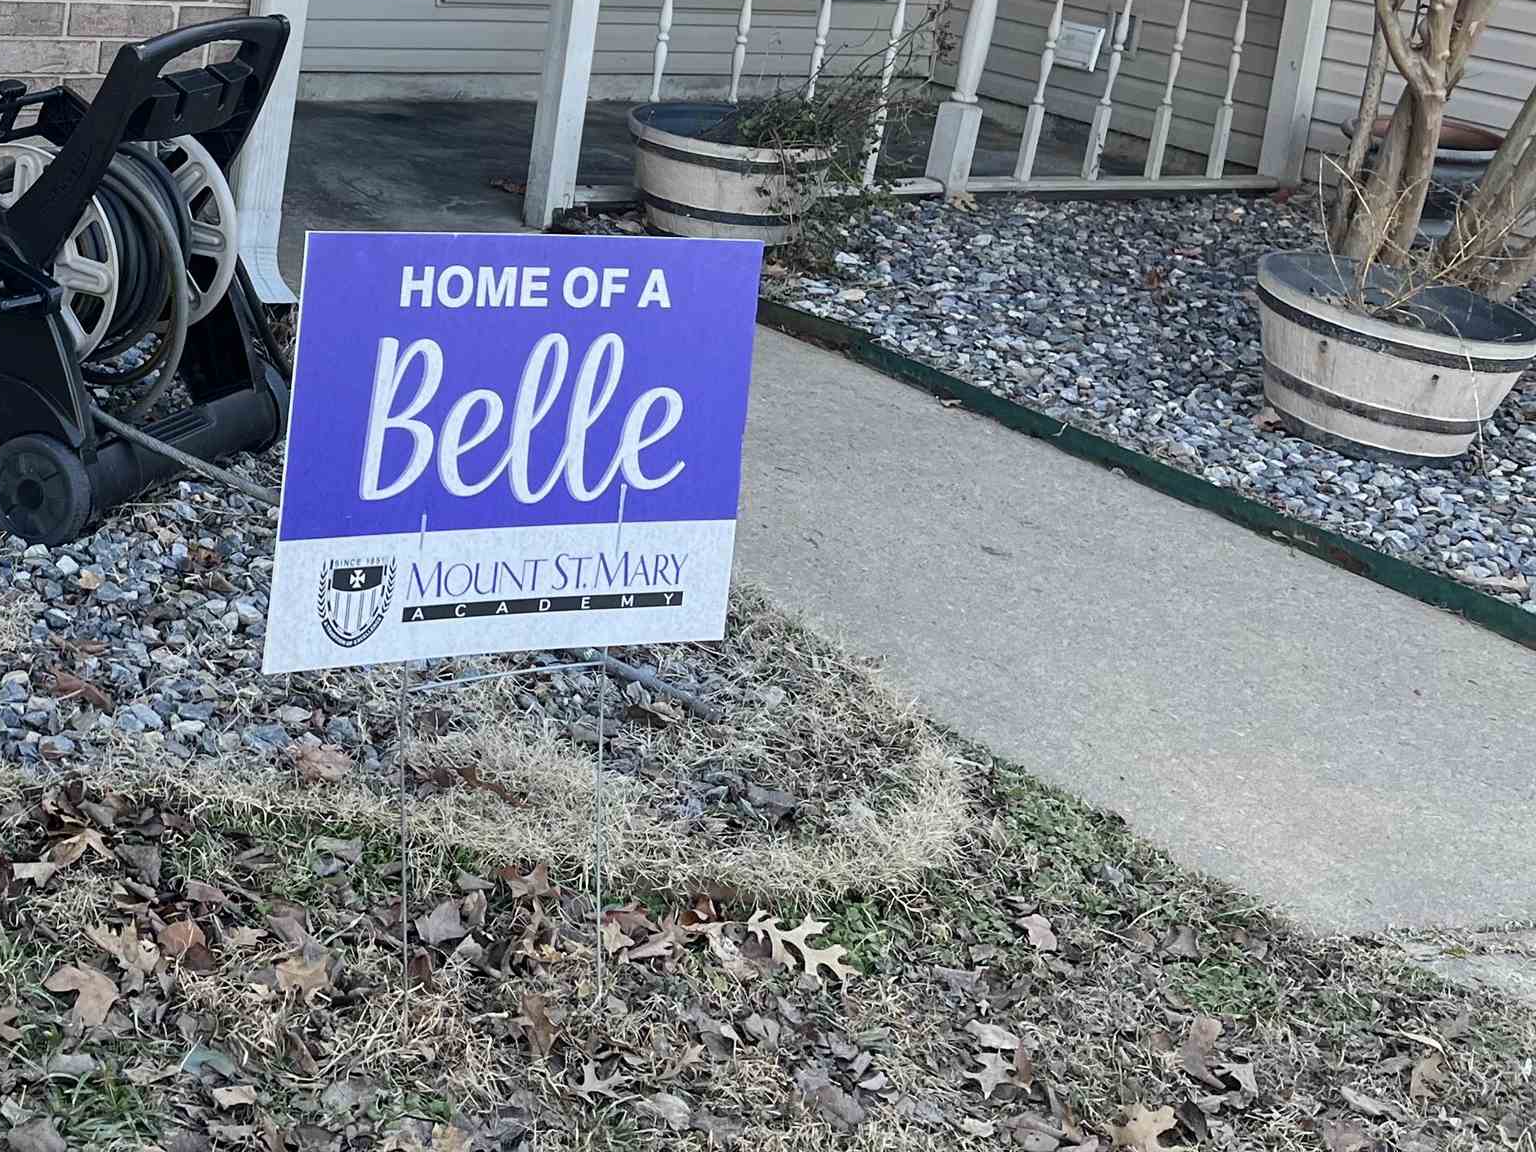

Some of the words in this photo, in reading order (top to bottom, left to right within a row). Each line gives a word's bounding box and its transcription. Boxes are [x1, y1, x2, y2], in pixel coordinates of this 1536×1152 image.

[399, 265, 551, 309] HOME
[562, 266, 630, 309] OF
[637, 268, 673, 309] A
[359, 332, 687, 505] Belle
[406, 558, 549, 601] MOUNT
[410, 592, 675, 621] ACADEMY
